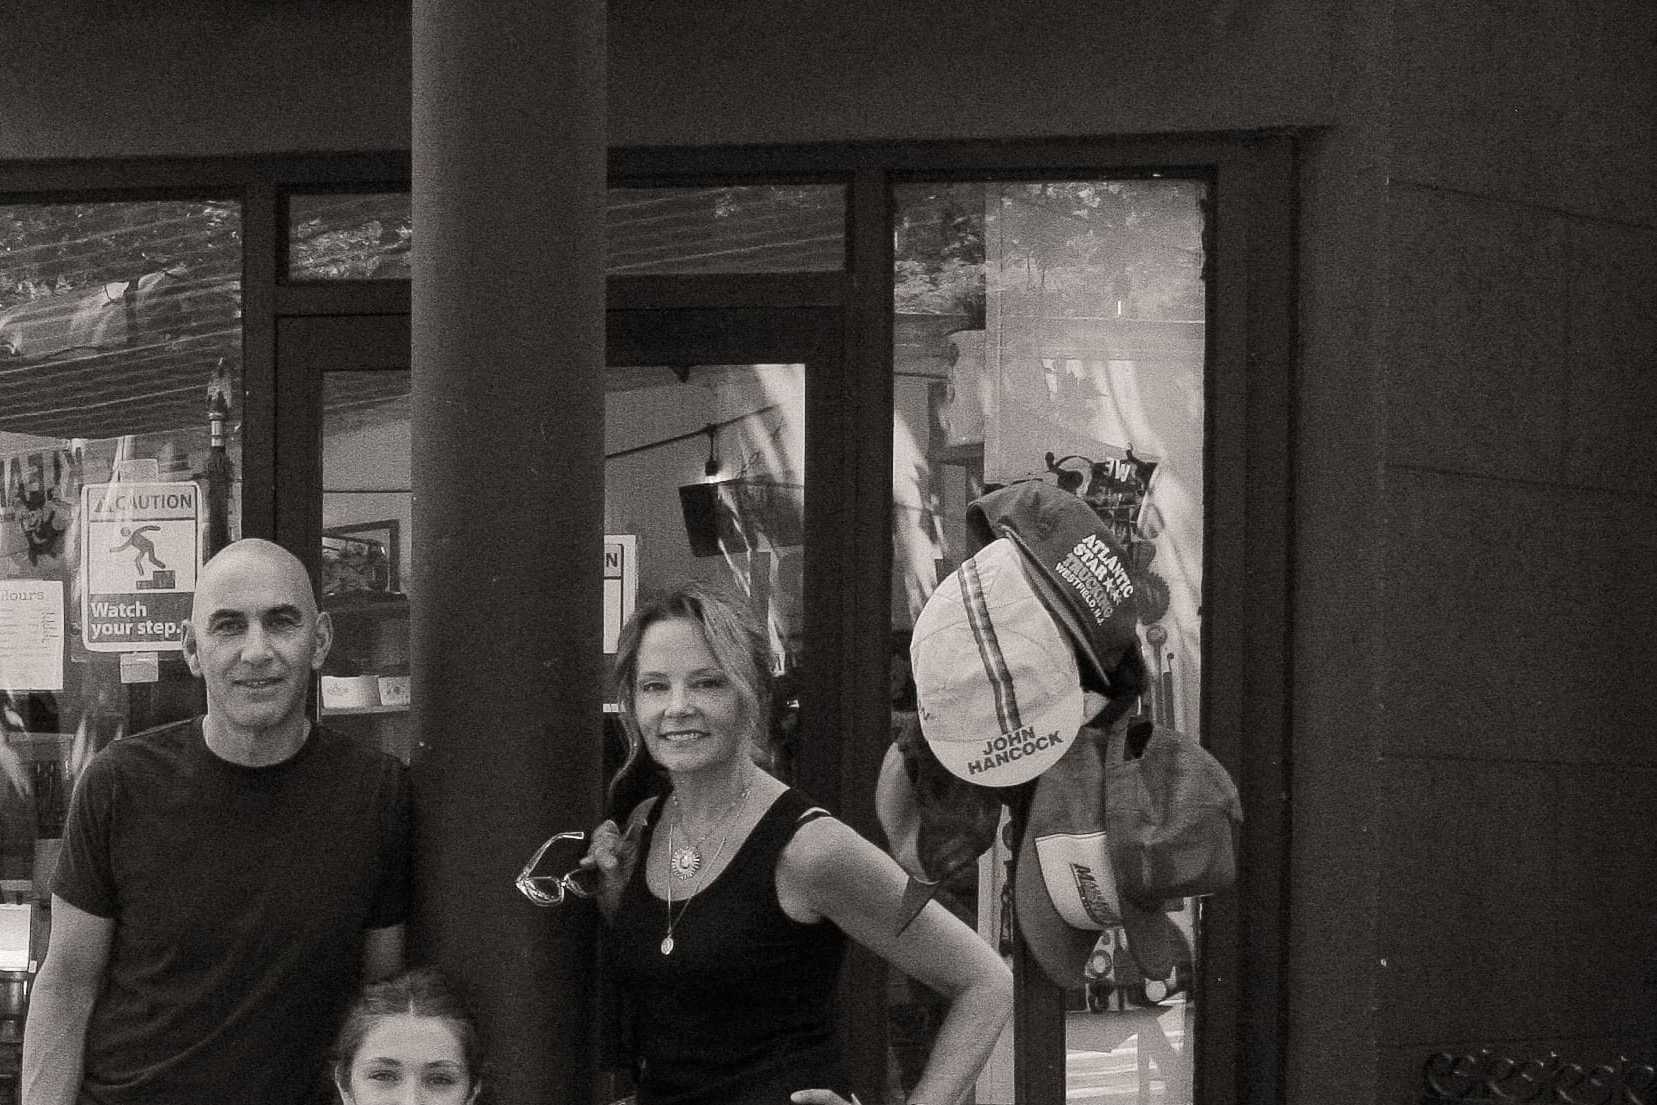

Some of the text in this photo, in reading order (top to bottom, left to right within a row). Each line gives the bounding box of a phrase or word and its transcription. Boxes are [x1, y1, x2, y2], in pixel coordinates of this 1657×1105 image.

[115, 494, 192, 510] CAUTION
[1073, 543, 1109, 581] STAR
[1081, 533, 1134, 598] ATLANTIC
[91, 601, 148, 618] Watch
[91, 620, 181, 639] your step.
[967, 730, 1065, 775] HANCOCK
[982, 726, 1036, 756] JOHN
